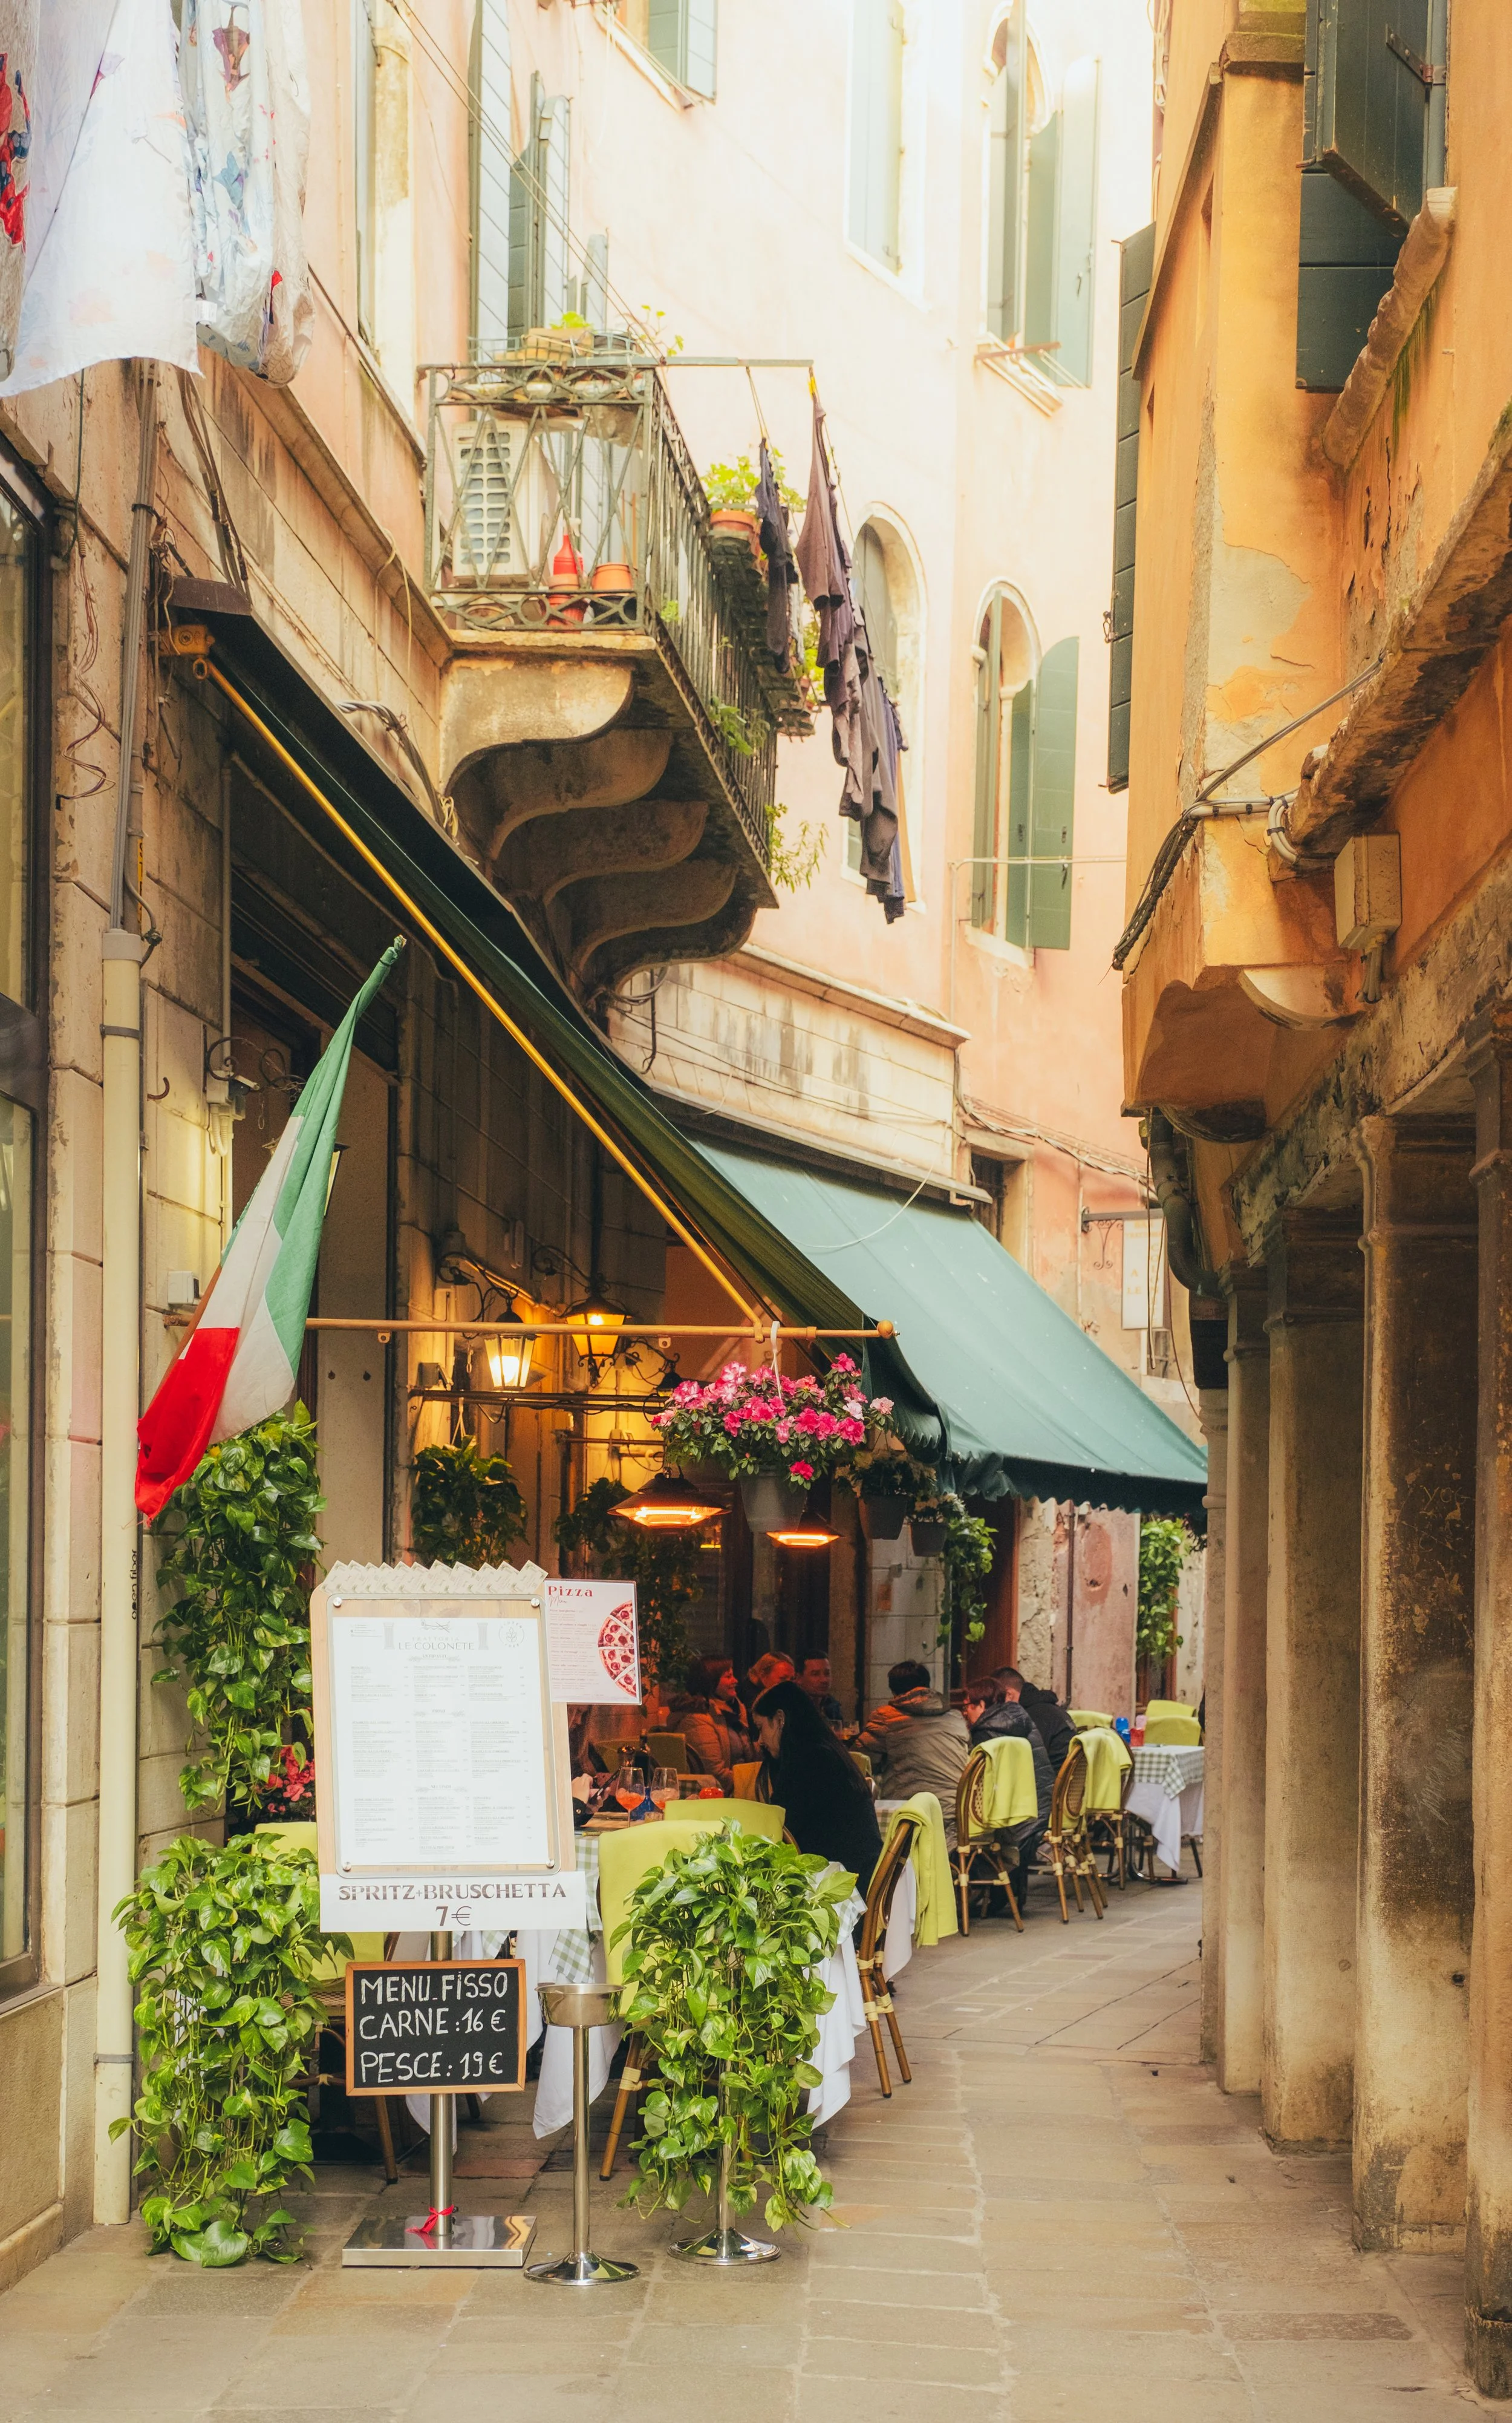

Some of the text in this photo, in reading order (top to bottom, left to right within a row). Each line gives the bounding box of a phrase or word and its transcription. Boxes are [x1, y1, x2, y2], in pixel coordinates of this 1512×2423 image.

[548, 1586, 593, 1597] Pizza
[360, 1975, 431, 2004] MENU
[359, 2007, 449, 2040] CARNE
